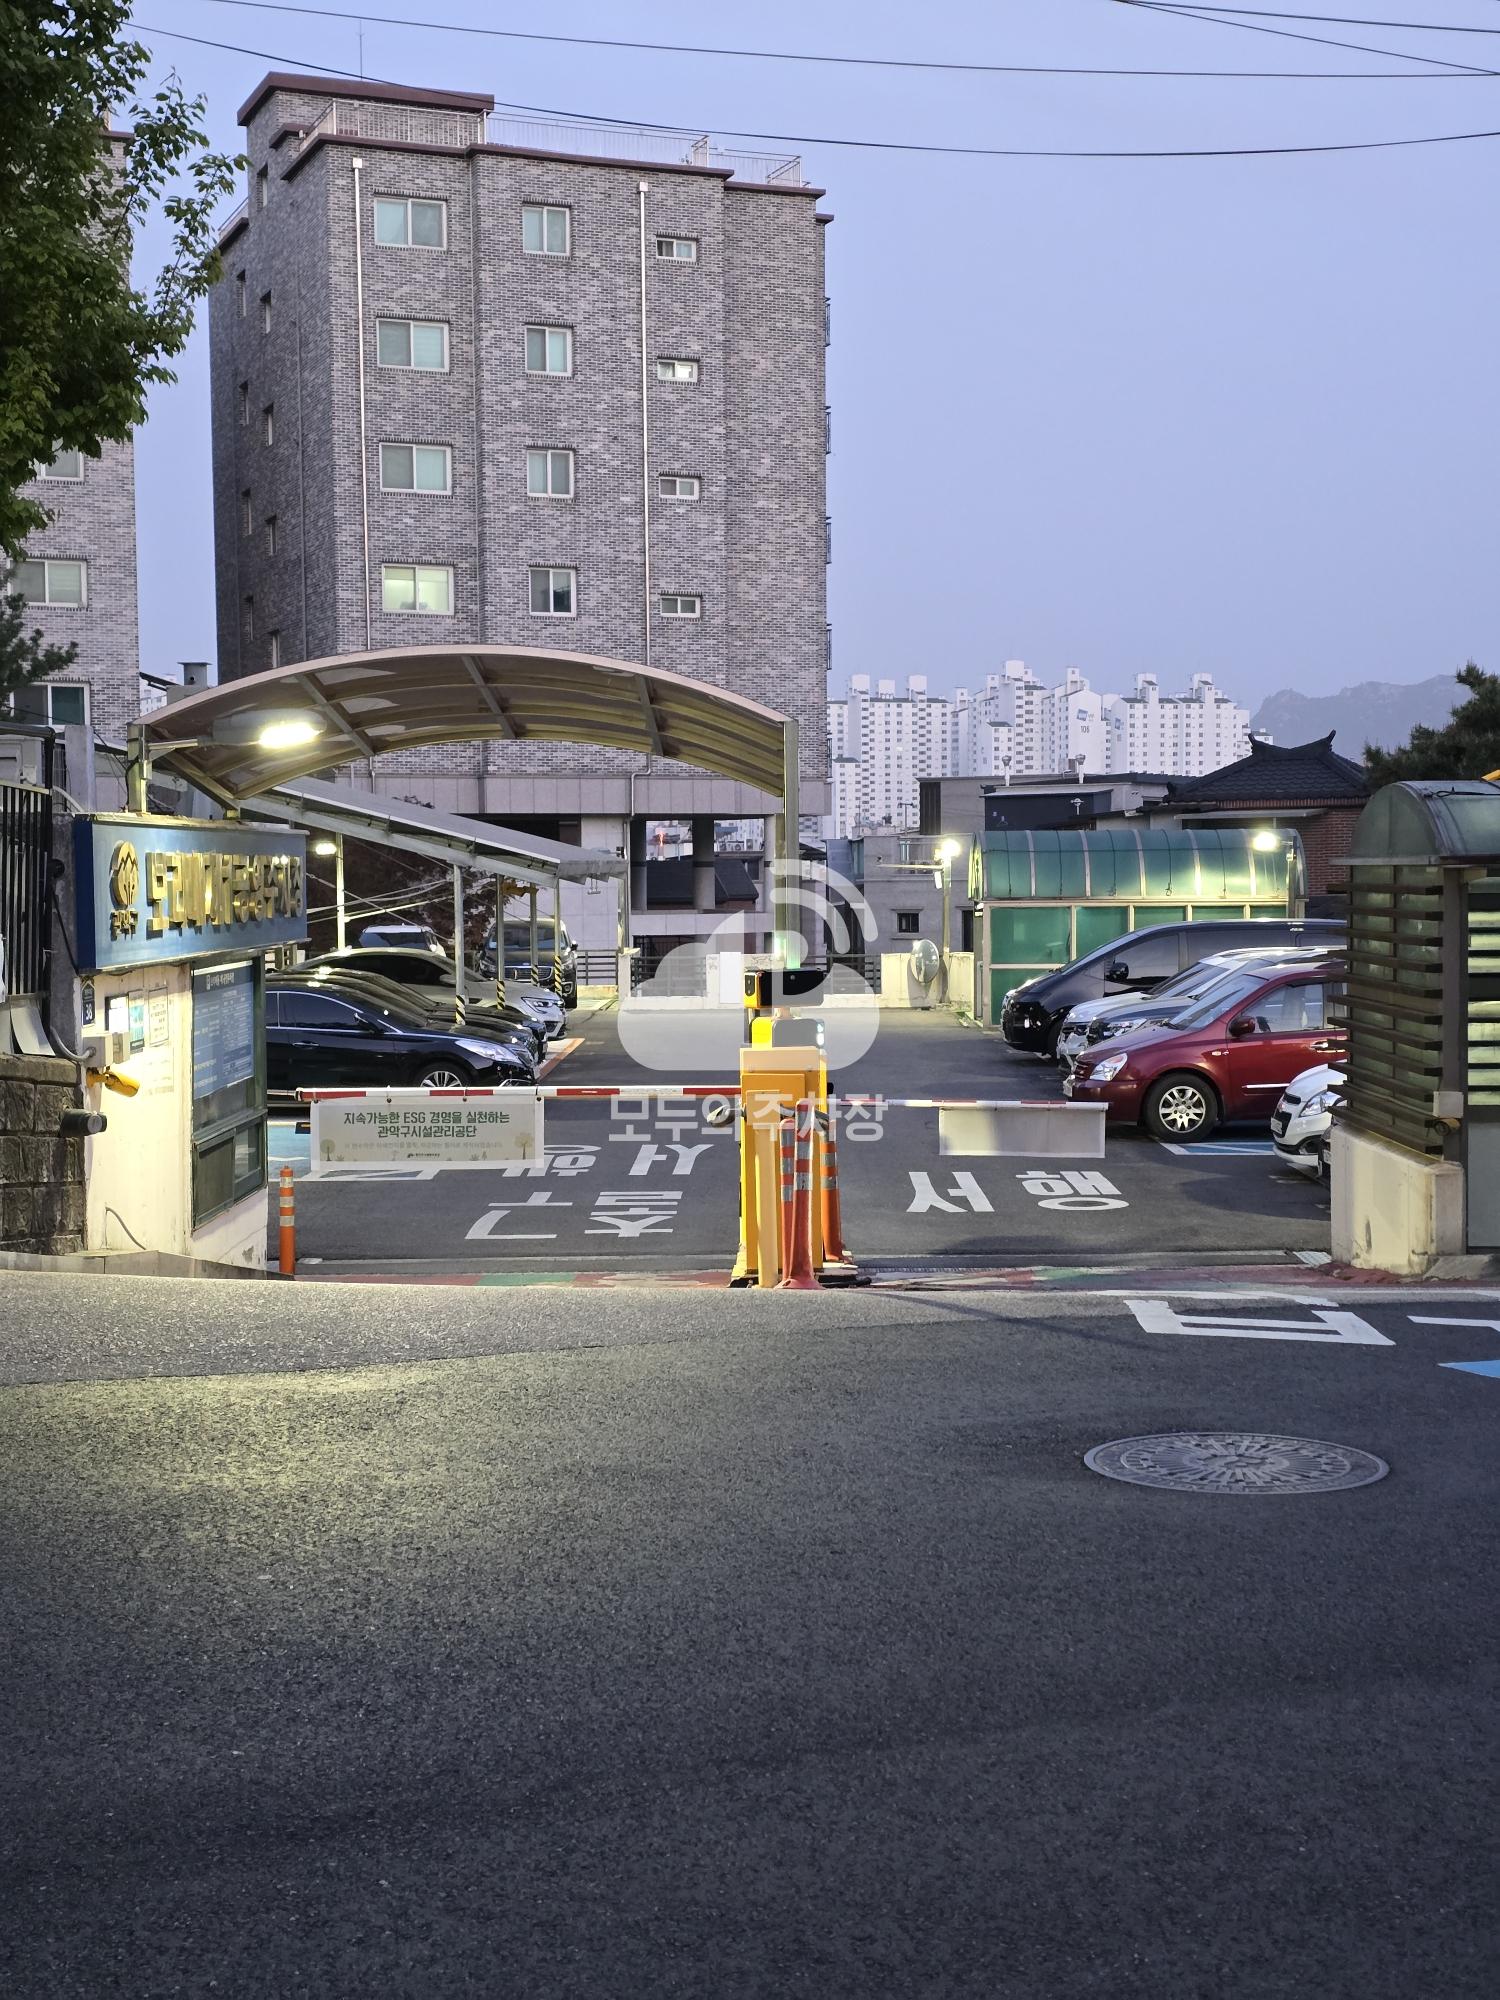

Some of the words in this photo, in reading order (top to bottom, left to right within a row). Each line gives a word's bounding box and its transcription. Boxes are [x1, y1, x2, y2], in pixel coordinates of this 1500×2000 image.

[85, 1003, 93, 1021] 38
[343, 1111, 401, 1125] 지속가능한
[403, 1112, 426, 1124] ESG
[429, 1111, 462, 1124] 경영을
[466, 1110, 511, 1124] 실천하는
[377, 1125, 478, 1139] 관악구시설관리공단
[906, 1169, 1130, 1213] 서행
[464, 1190, 684, 1240] 출구
